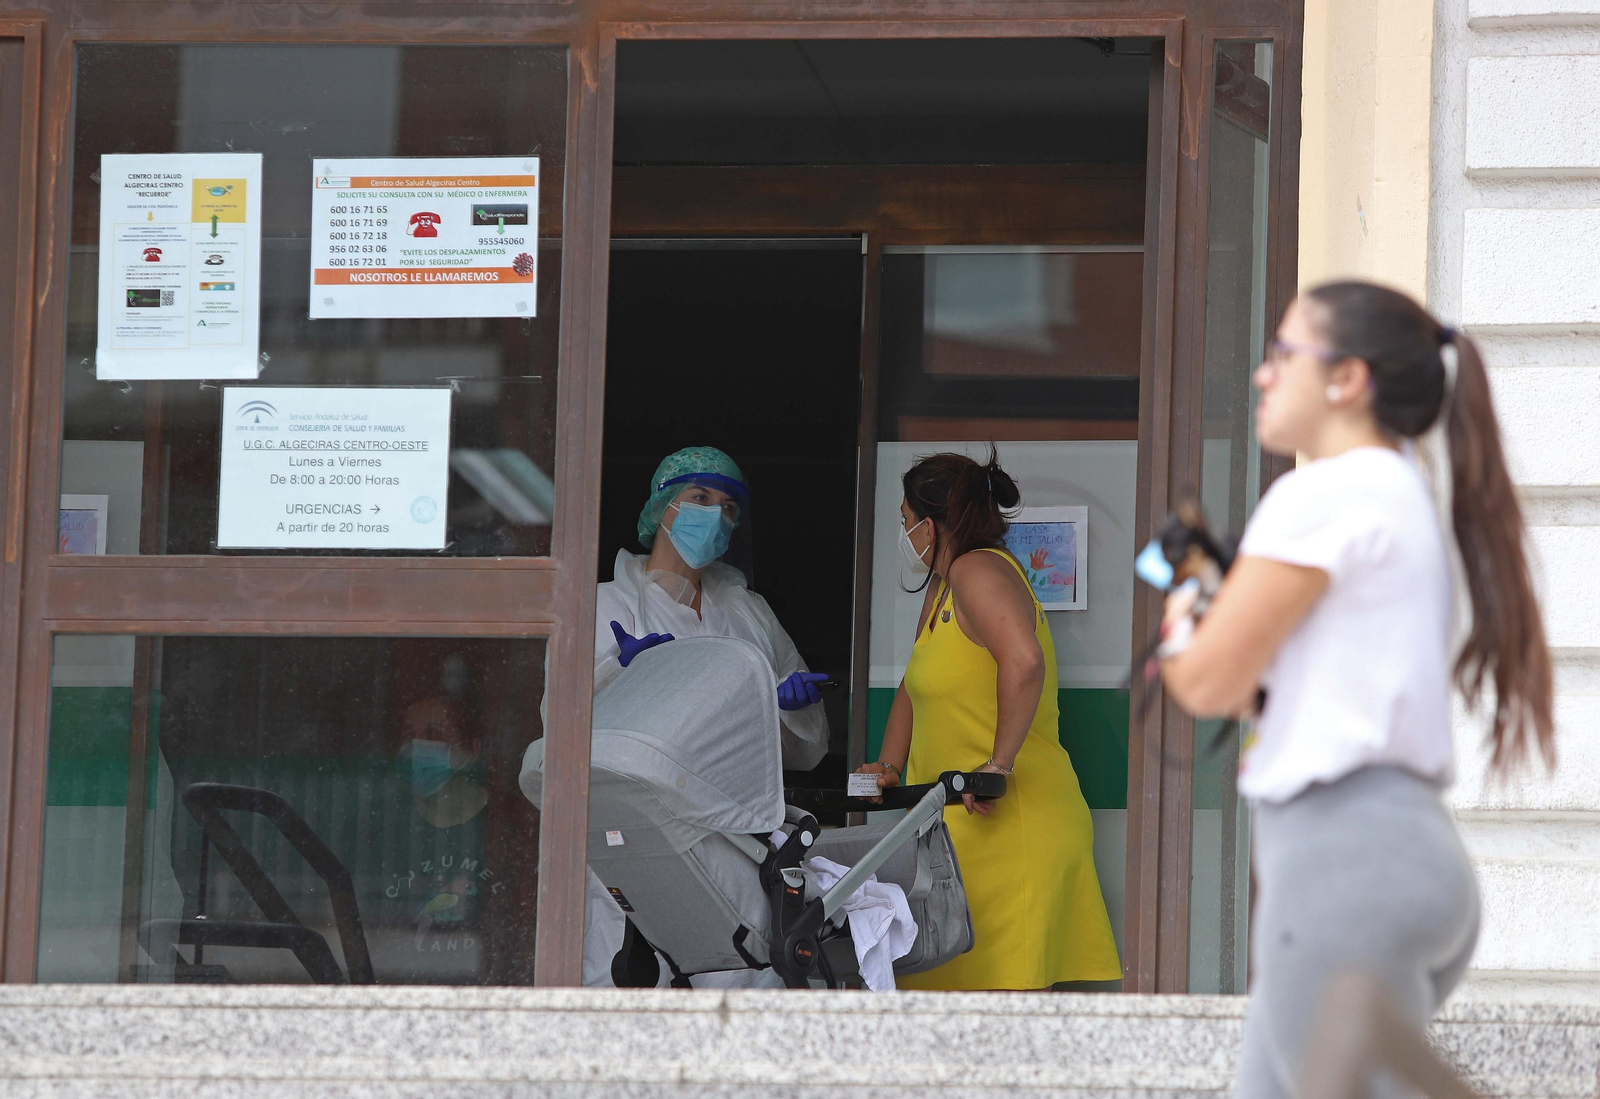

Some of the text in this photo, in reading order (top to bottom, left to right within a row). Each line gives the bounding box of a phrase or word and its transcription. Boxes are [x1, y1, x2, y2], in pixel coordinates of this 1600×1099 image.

[350, 272, 499, 282] NOSOTROS LE LLAMAREMOS
[243, 440, 428, 449] U.G.C. ALGECIRAS CENTRO-OESTE
[289, 457, 324, 467] Lunes
[338, 457, 381, 467] Viernes
[270, 474, 286, 484] De
[290, 474, 314, 485] 8:00
[329, 475, 361, 485] 20:00
[365, 475, 399, 485] Horas
[286, 504, 361, 514] URGENCIAS
[276, 522, 389, 534] A partir de 20 horas
[1025, 526, 1049, 534] CASA
[1037, 536, 1063, 544] SALUD
